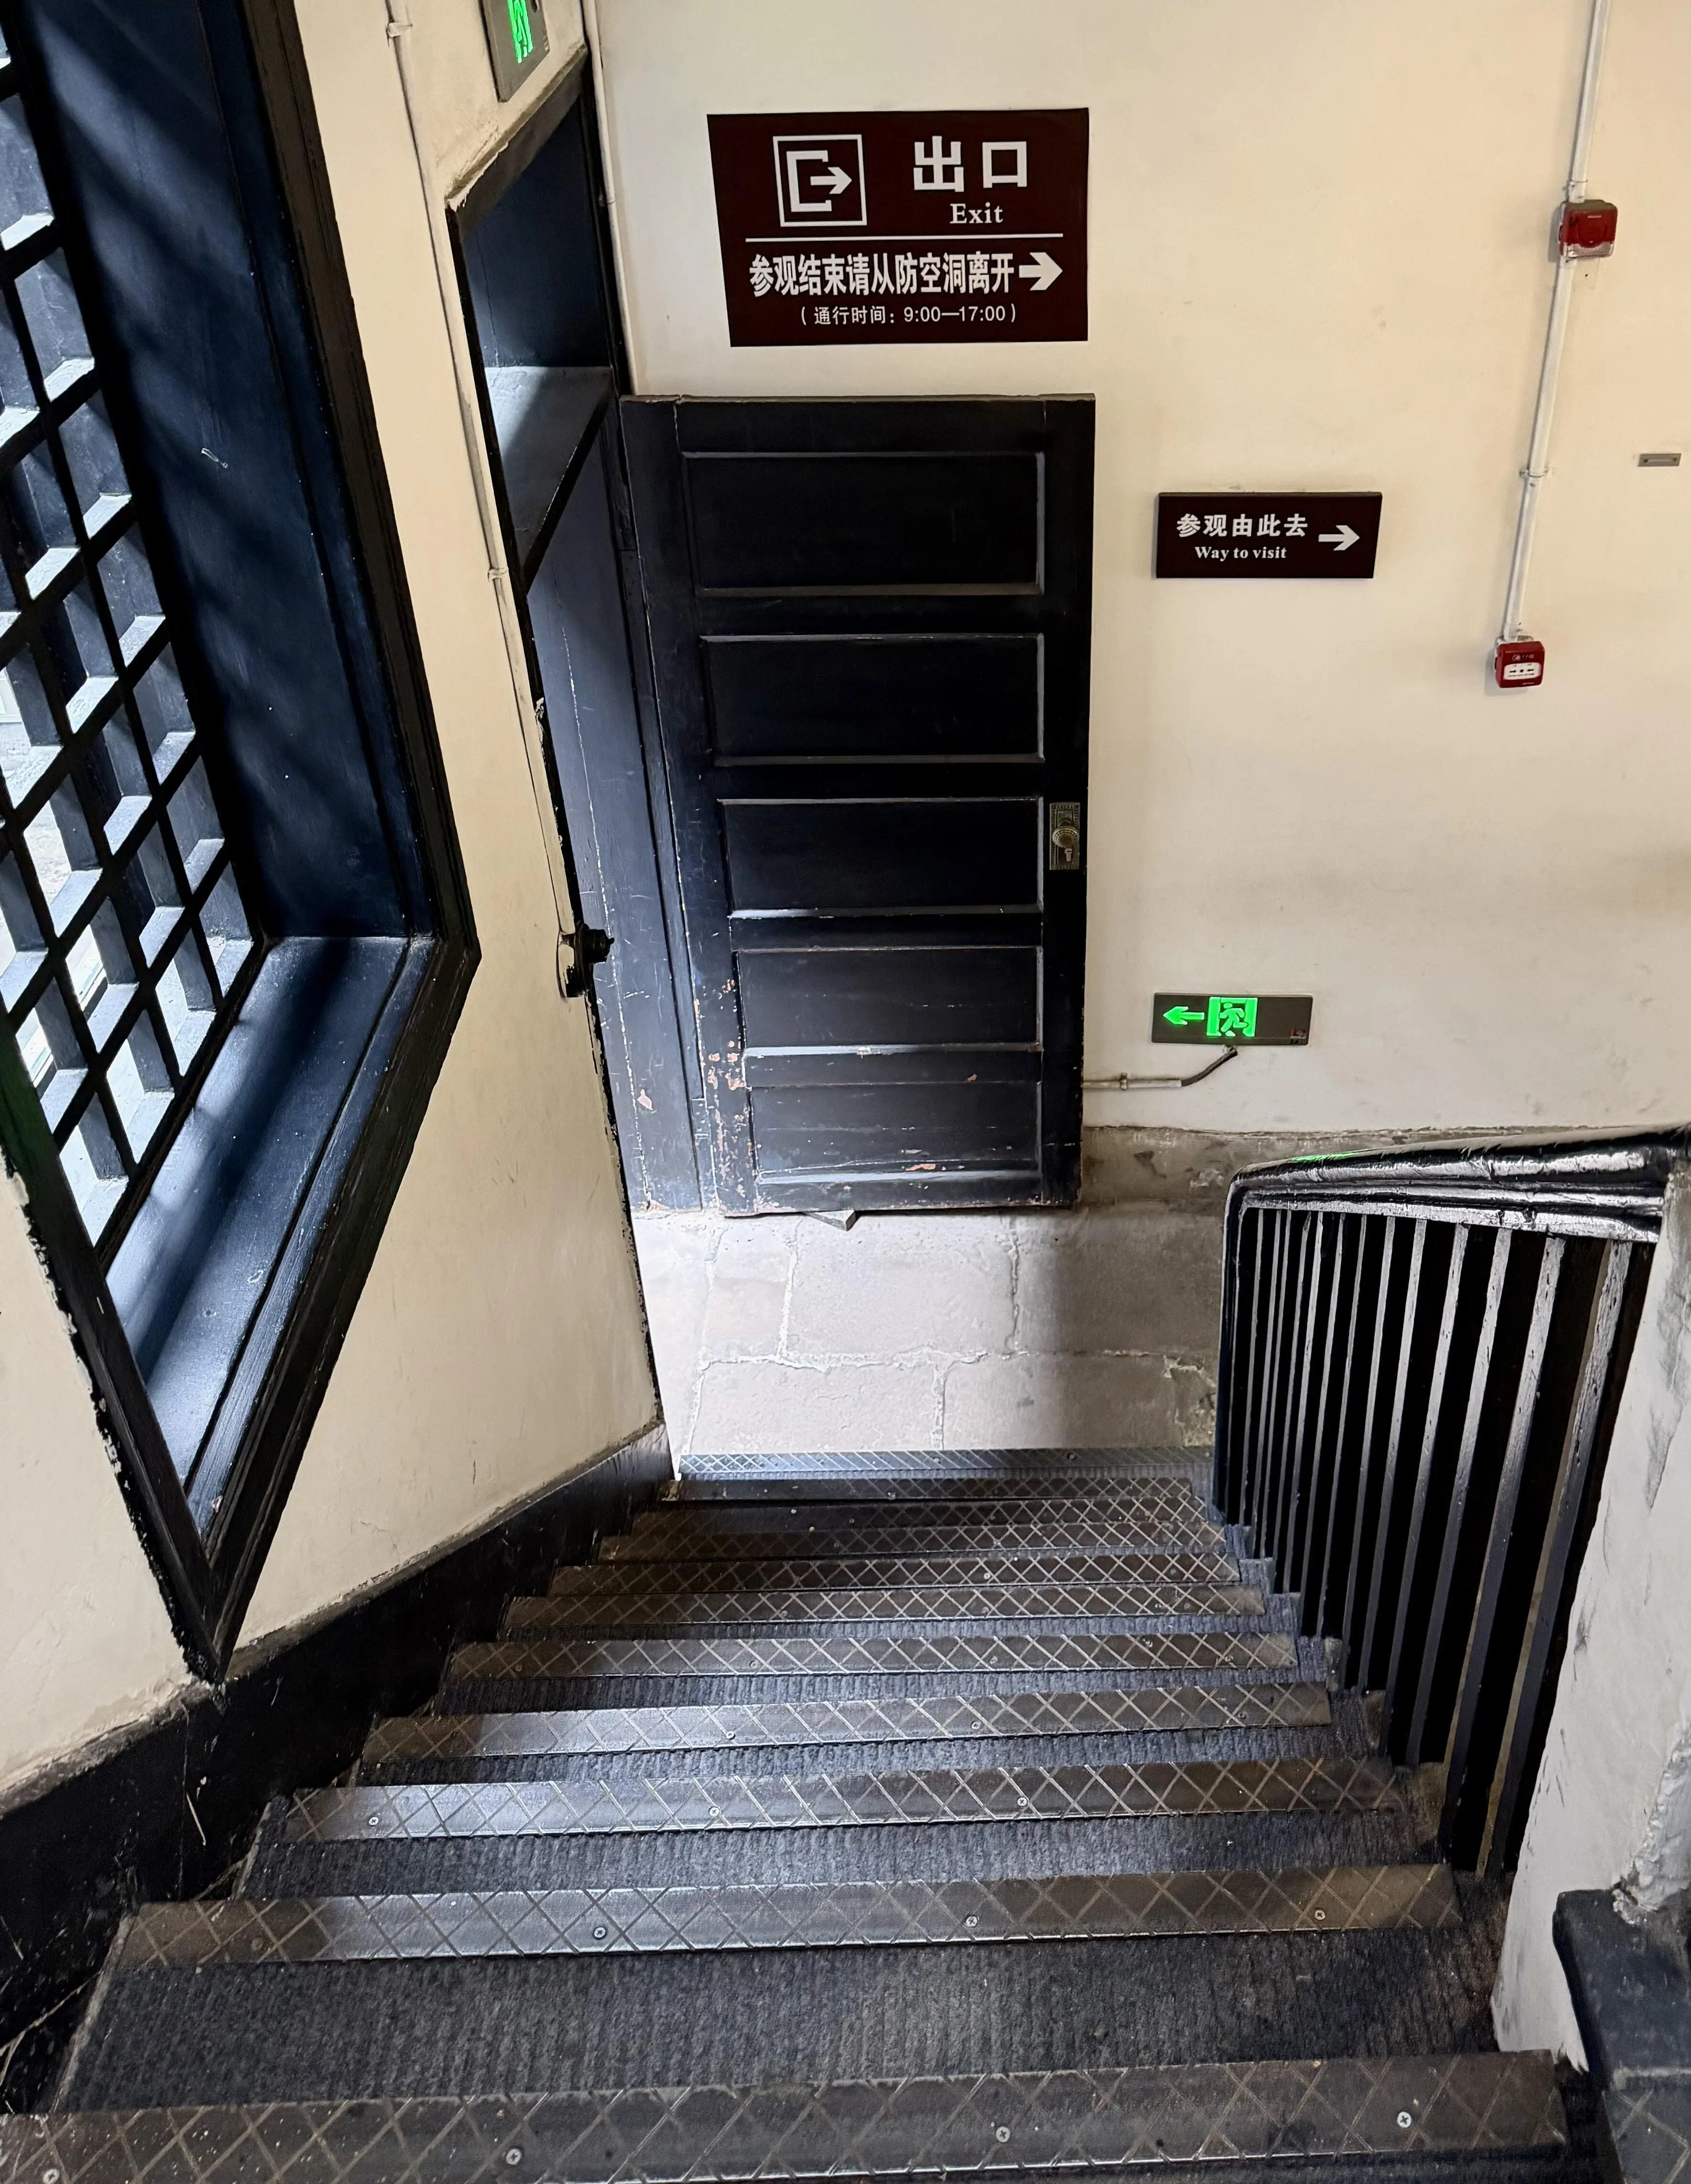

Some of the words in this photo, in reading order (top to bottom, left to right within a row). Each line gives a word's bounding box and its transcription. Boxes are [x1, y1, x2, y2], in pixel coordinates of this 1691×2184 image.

[914, 136, 1027, 192] 出口
[950, 202, 1003, 224] Exit
[750, 251, 1014, 297] 参观结束请从防空洞离开
[1177, 514, 1307, 537] 参观由此去
[1195, 547, 1229, 561] Way
[1234, 548, 1248, 558] to
[1253, 547, 1286, 558] visit
